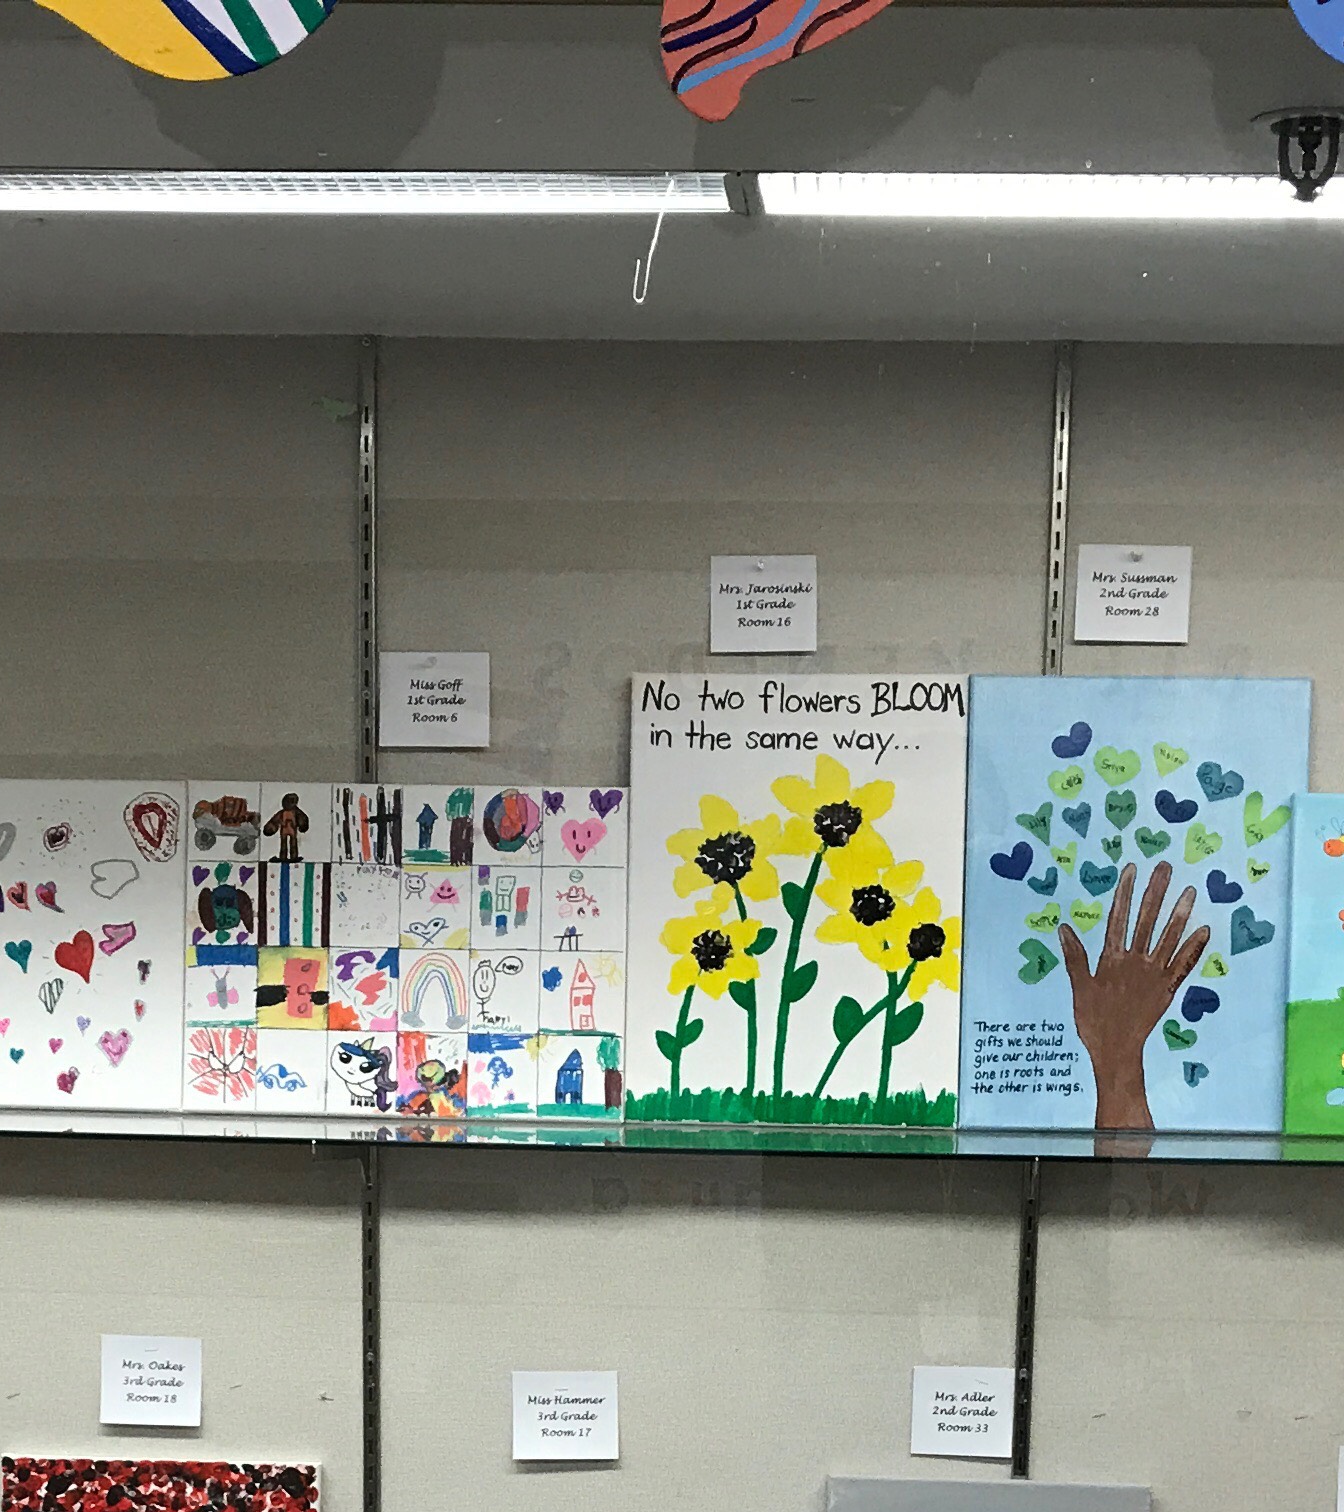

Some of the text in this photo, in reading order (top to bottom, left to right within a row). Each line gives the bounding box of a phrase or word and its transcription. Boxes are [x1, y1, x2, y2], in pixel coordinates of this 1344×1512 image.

[1120, 571, 1178, 584] Sussman
[745, 581, 813, 595] Jarosinski
[1099, 589, 1169, 600] 2nd Grade
[736, 598, 796, 610] 1st Grade
[1105, 606, 1160, 617] Room 28
[737, 616, 792, 627] Room 16
[409, 678, 463, 691] Miss Goff
[407, 694, 466, 706] 1st Grade
[642, 680, 966, 717] No two flowers BLOOM
[412, 712, 458, 723] Room 6
[650, 720, 920, 765] in the same way...
[974, 1019, 1065, 1032] There are two
[974, 1034, 1063, 1053] gifts we should
[974, 1049, 1079, 1069] give our children;
[974, 1065, 1072, 1080] one is roots and
[971, 1081, 1084, 1097] the other is wings.
[148, 1360, 185, 1372] Oakes
[123, 1375, 184, 1387] 3rd Grade
[126, 1393, 178, 1404] Room 18
[527, 1395, 552, 1405] Miss
[960, 1391, 995, 1403] Adler
[537, 1411, 598, 1422] 3rd Grade
[932, 1405, 998, 1417] 2nd Grade
[541, 1427, 592, 1438] Room 17
[937, 1422, 989, 1433] Room 33
